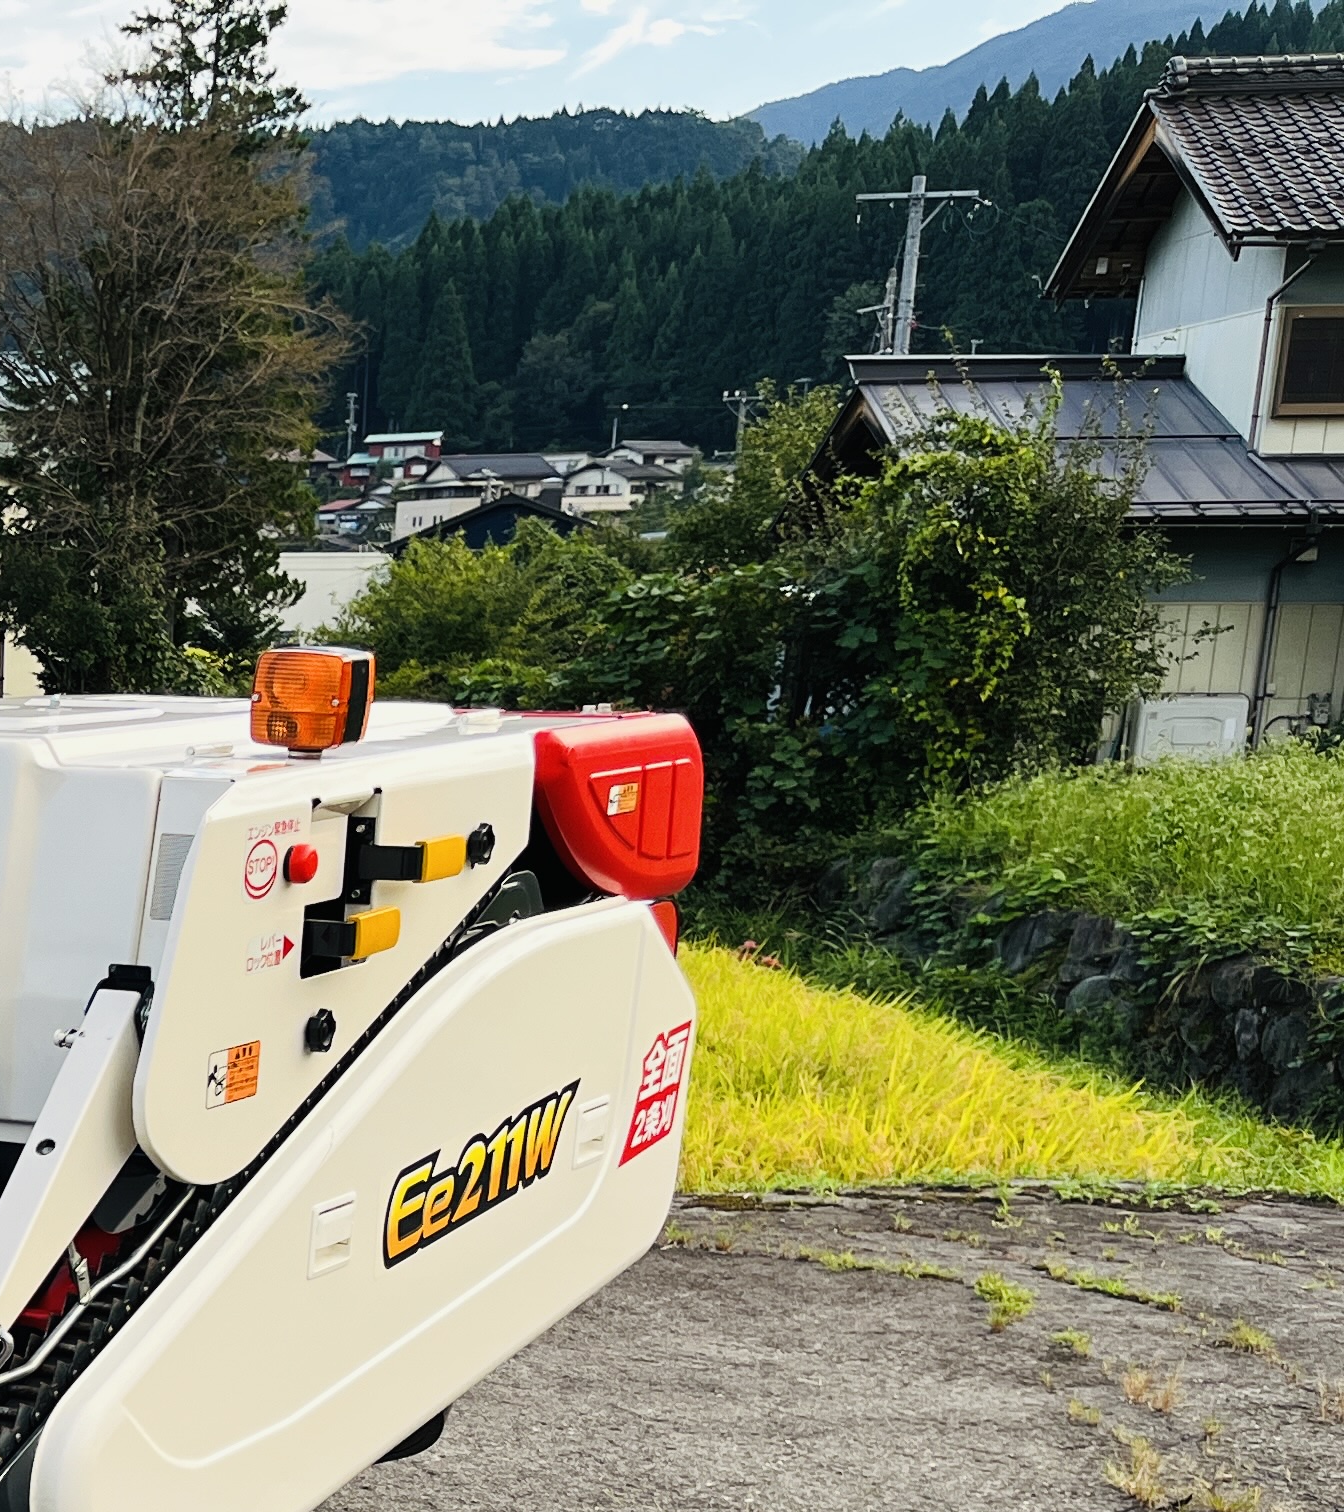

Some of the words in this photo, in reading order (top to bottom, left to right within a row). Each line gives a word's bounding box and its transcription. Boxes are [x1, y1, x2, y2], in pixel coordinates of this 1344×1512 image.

[638, 1028, 689, 1103] 全面
[630, 1091, 677, 1149] 2条刈
[384, 1083, 576, 1265] Ee211W
